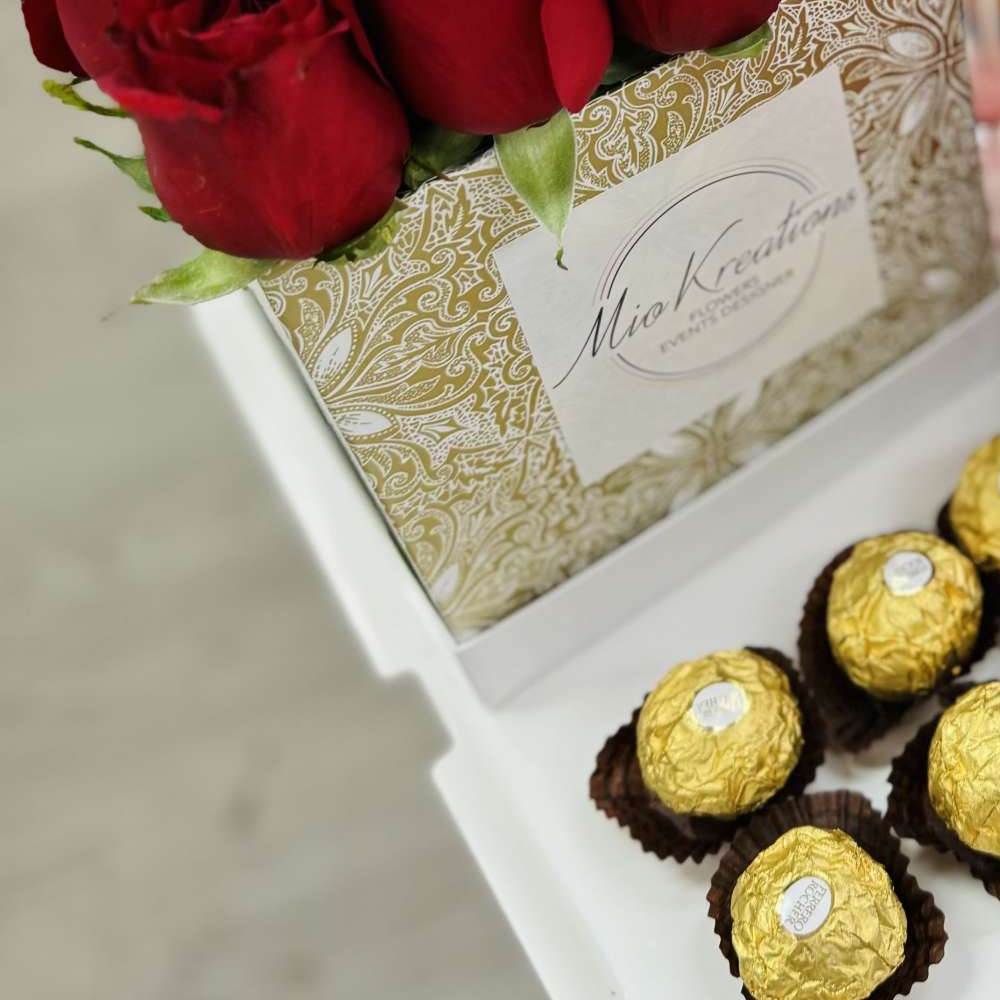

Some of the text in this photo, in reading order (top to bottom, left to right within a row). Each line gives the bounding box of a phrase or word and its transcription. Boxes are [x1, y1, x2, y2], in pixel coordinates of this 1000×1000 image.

[553, 188, 857, 389] Mio Kreations
[659, 313, 719, 354] EVENTS
[784, 880, 818, 926] ROCHER
[793, 887, 828, 932] FERRERO
